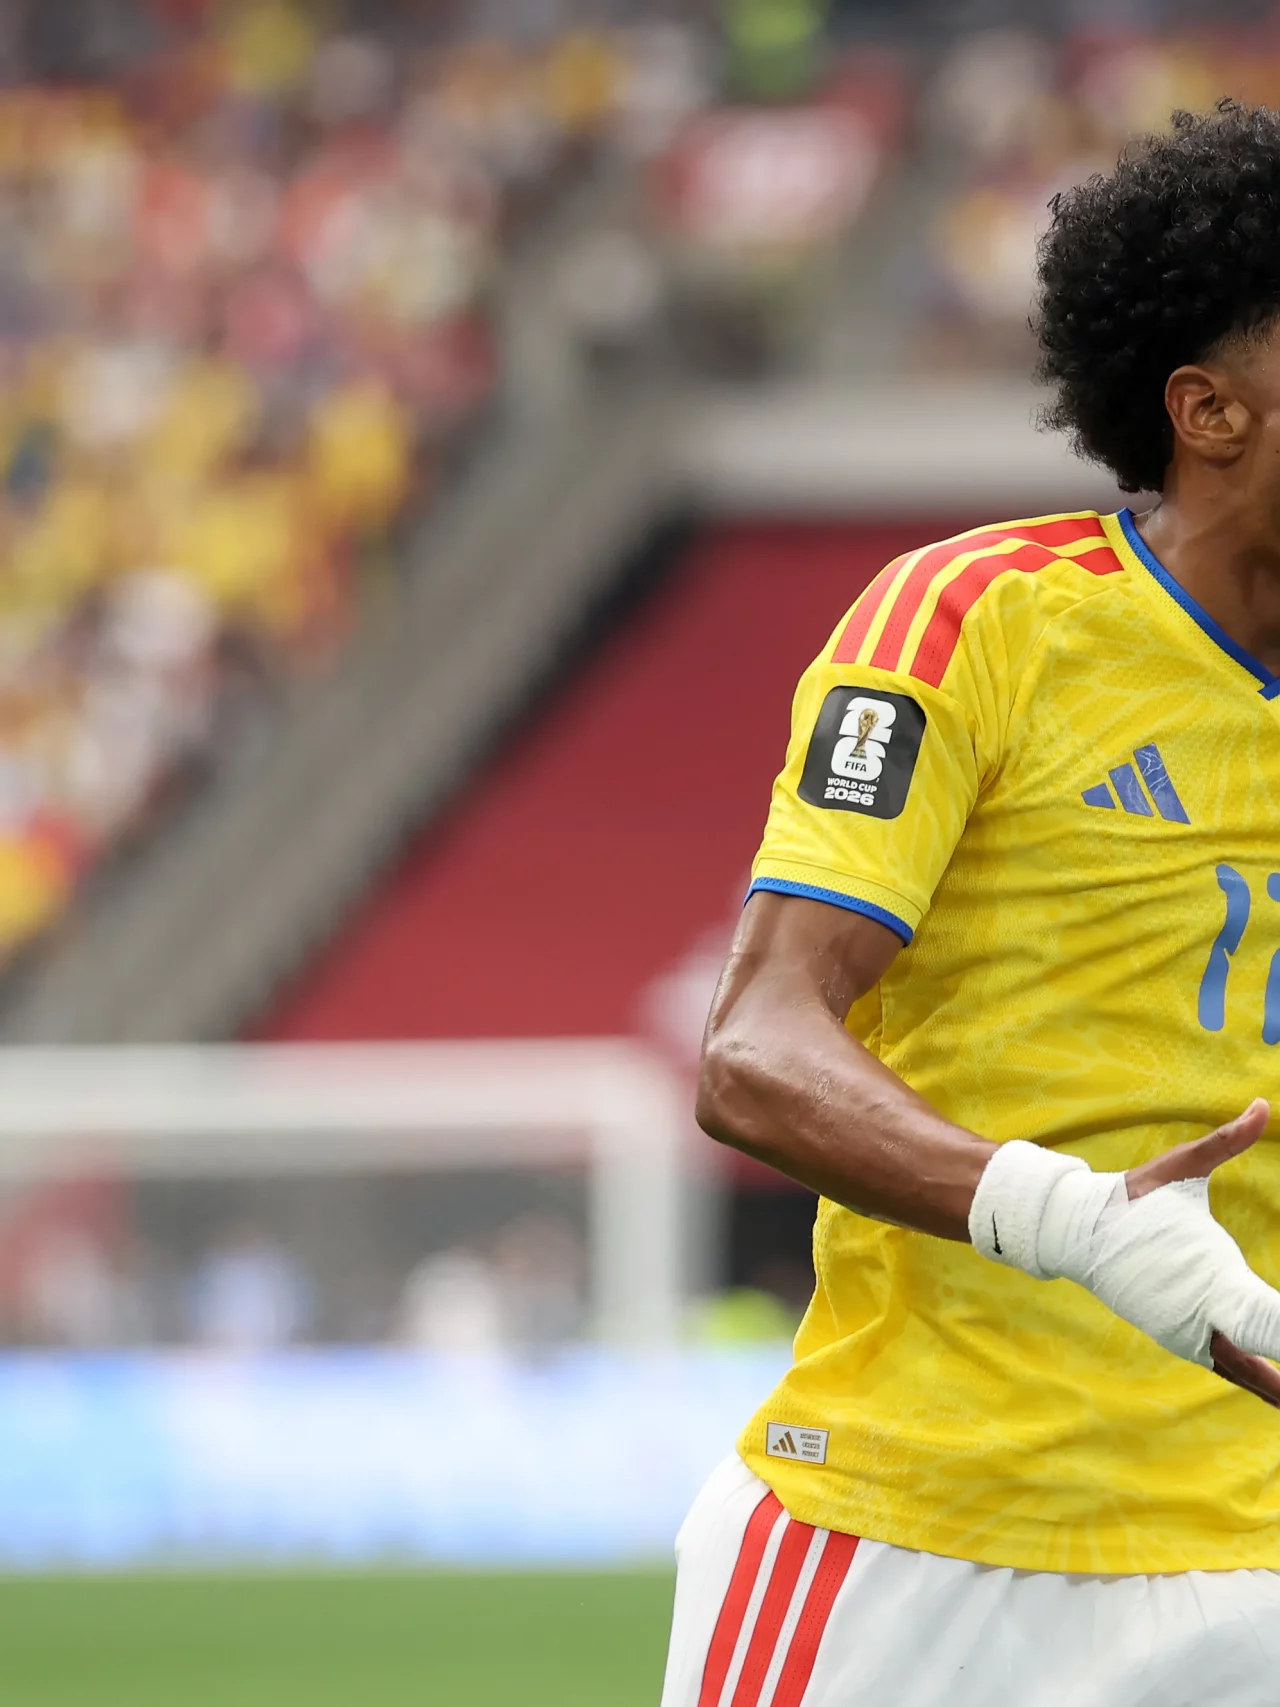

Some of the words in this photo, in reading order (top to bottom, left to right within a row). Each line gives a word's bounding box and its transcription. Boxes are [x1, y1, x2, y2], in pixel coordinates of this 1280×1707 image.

[844, 761, 867, 772] FIFA
[827, 777, 857, 790] WORLD
[858, 783, 878, 793] CUP
[824, 787, 875, 806] 2026
